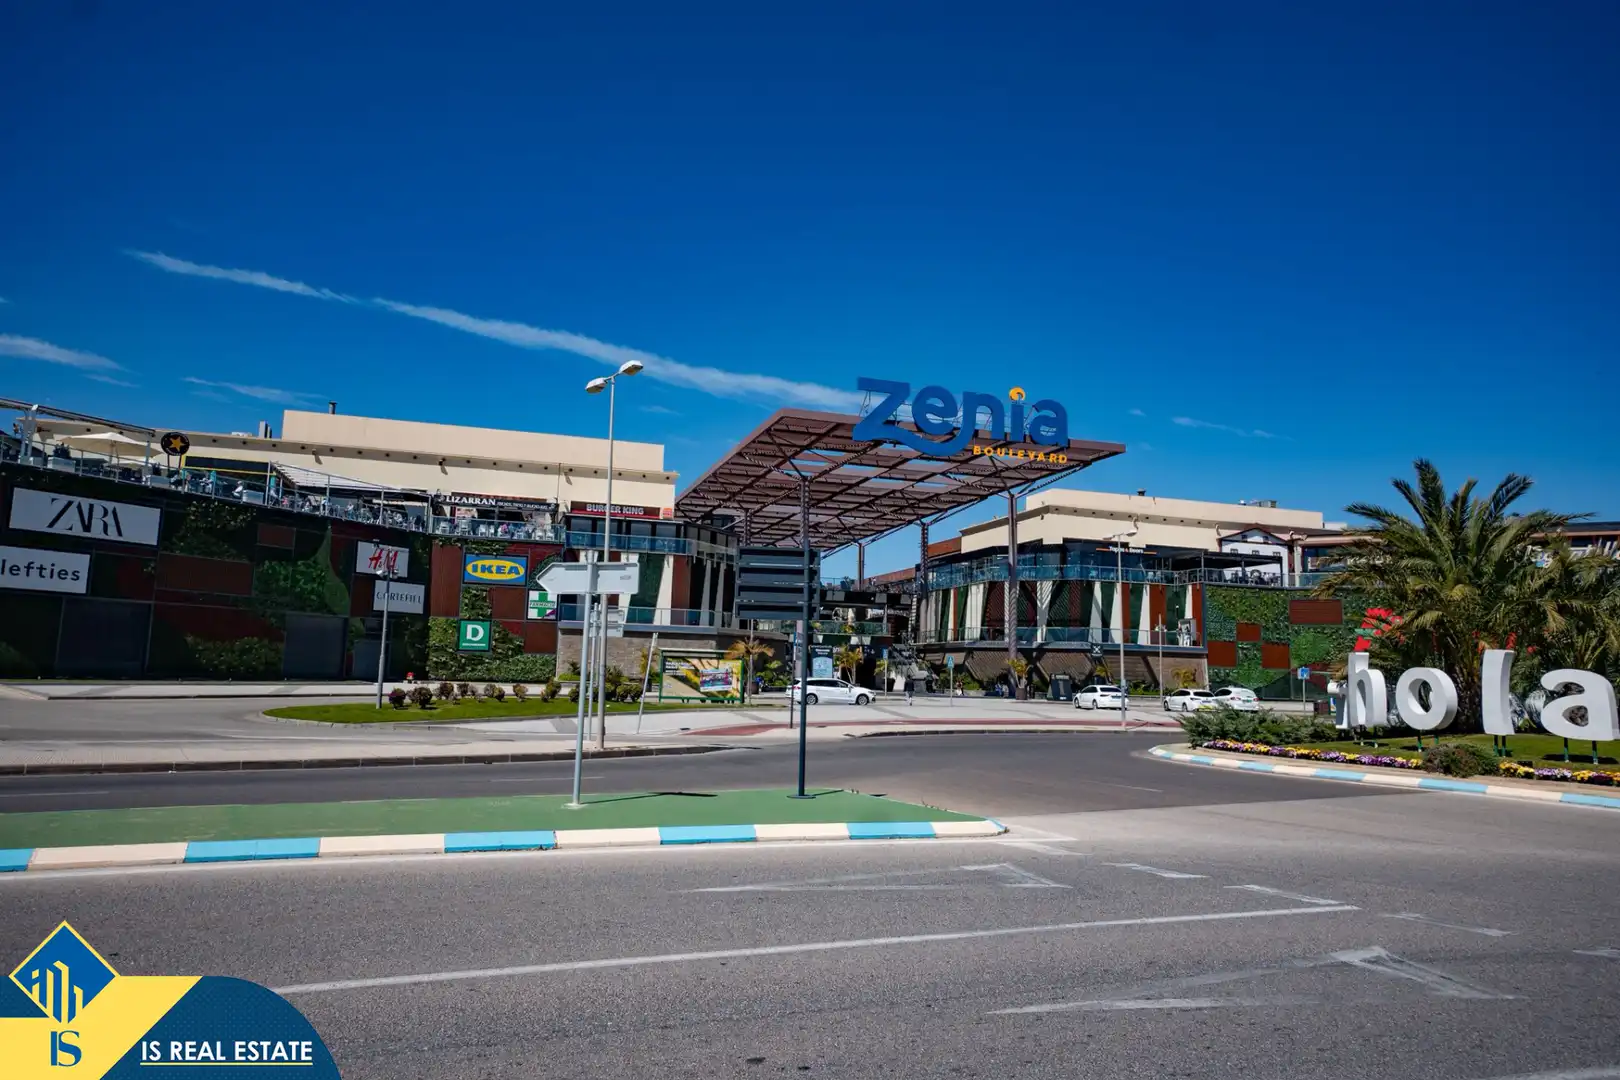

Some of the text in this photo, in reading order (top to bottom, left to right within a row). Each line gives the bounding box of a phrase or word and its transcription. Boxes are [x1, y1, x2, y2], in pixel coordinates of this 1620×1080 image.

[852, 377, 1069, 456] Zenia
[973, 445, 1068, 464] BOULEVARD
[445, 495, 496, 506] LIZARRAN
[46, 497, 123, 537] ZARA
[622, 506, 645, 515] KING
[0, 559, 81, 581] lefties
[368, 547, 399, 574] H&M
[471, 563, 521, 575] IKEA
[466, 624, 484, 642] D
